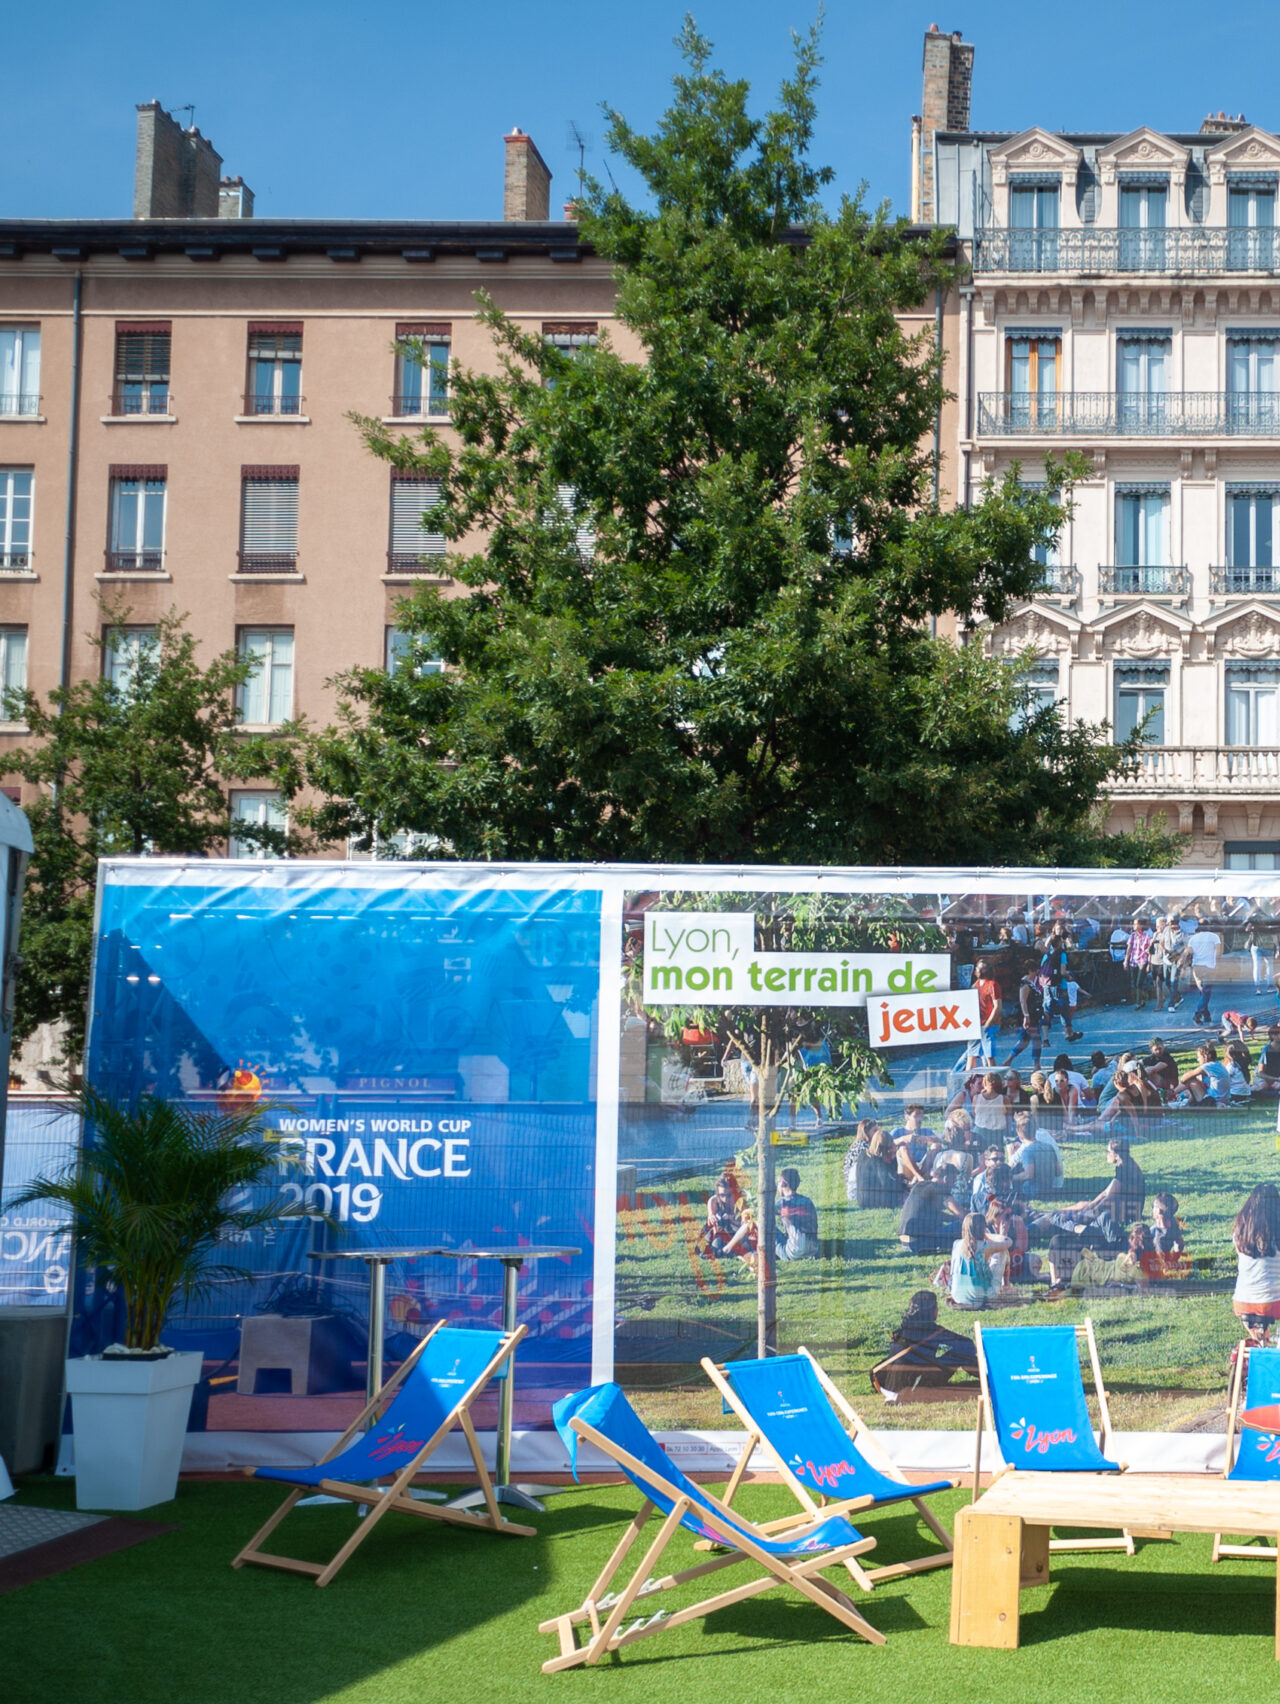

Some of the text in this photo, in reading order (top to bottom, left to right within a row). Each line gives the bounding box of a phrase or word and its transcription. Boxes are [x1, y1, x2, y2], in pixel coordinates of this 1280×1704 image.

[651, 919, 740, 961] Lyon,
[650, 959, 938, 993] mon terrain de
[879, 1002, 973, 1043] jeux.
[359, 1077, 432, 1089] PIGNOL
[279, 1118, 472, 1133] WOMEN'S WORLD CUP
[278, 1137, 472, 1181] FRANCE
[278, 1182, 384, 1223] 2019
[1025, 1425, 1077, 1454] Lyon
[806, 1461, 856, 1487] Lyon
